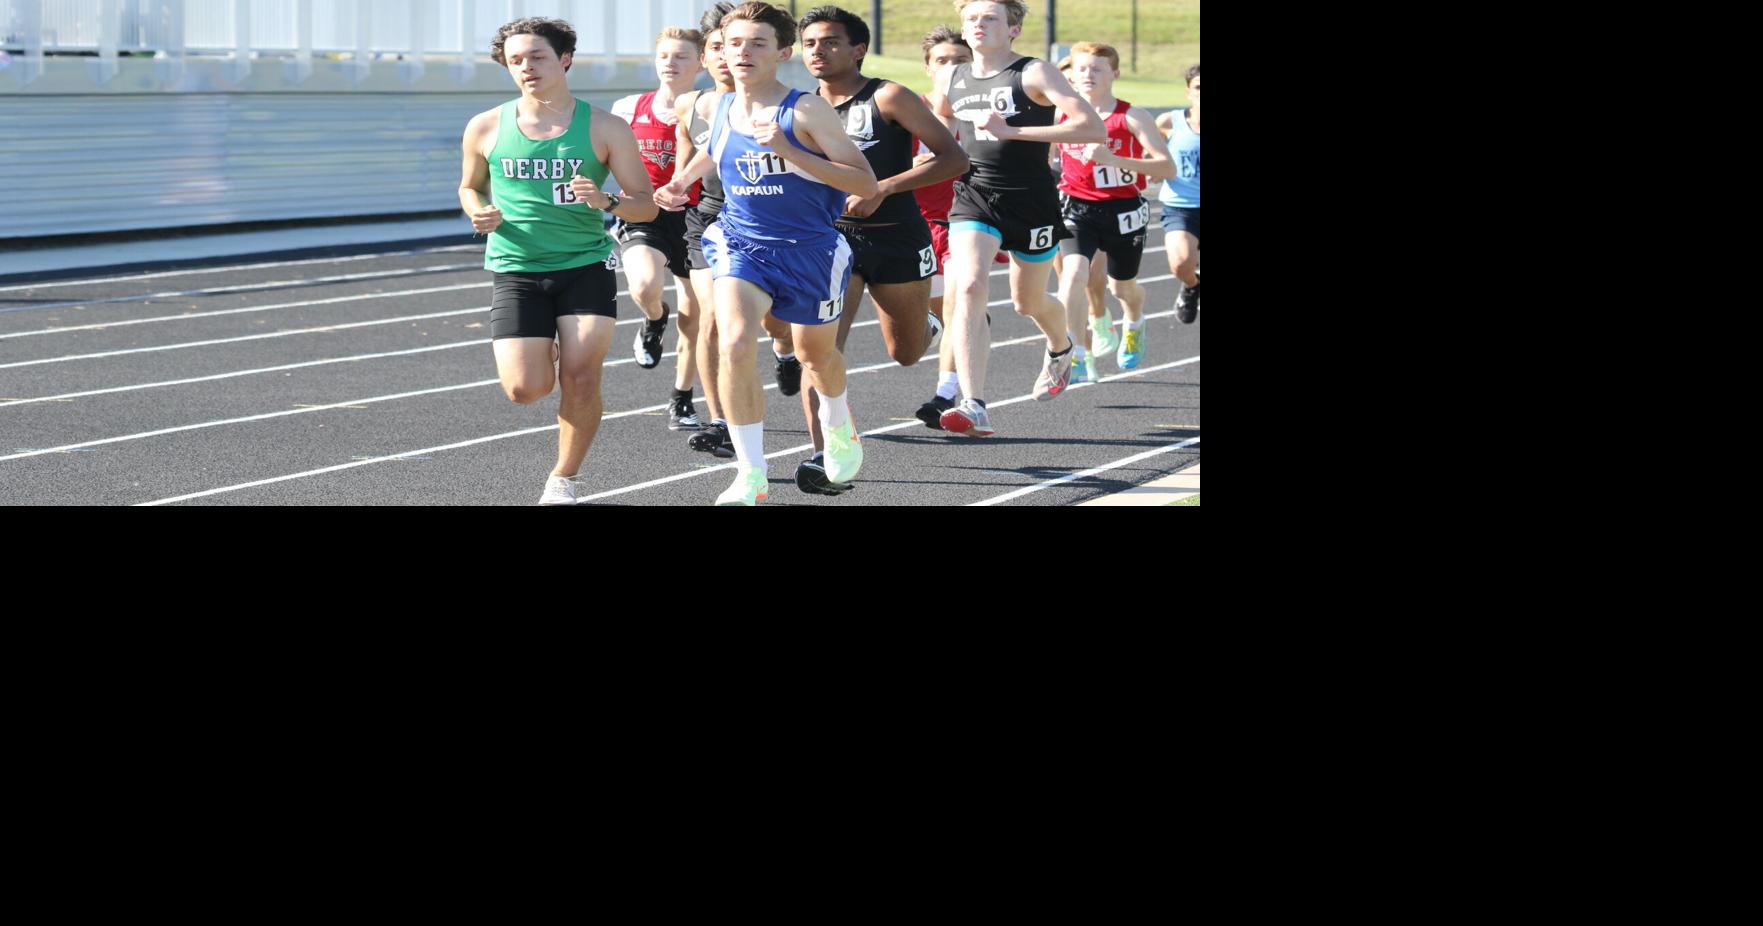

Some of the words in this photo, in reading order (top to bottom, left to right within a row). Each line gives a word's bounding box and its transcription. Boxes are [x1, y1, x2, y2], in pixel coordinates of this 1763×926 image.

[994, 90, 1007, 112] 6
[852, 108, 866, 132] 9
[500, 157, 583, 180] DERBY
[761, 152, 786, 173] 11
[554, 183, 577, 204] 13
[731, 184, 784, 196] KAPAUN
[1035, 228, 1049, 248] 6
[922, 248, 934, 274] 9
[826, 295, 842, 317] 11
